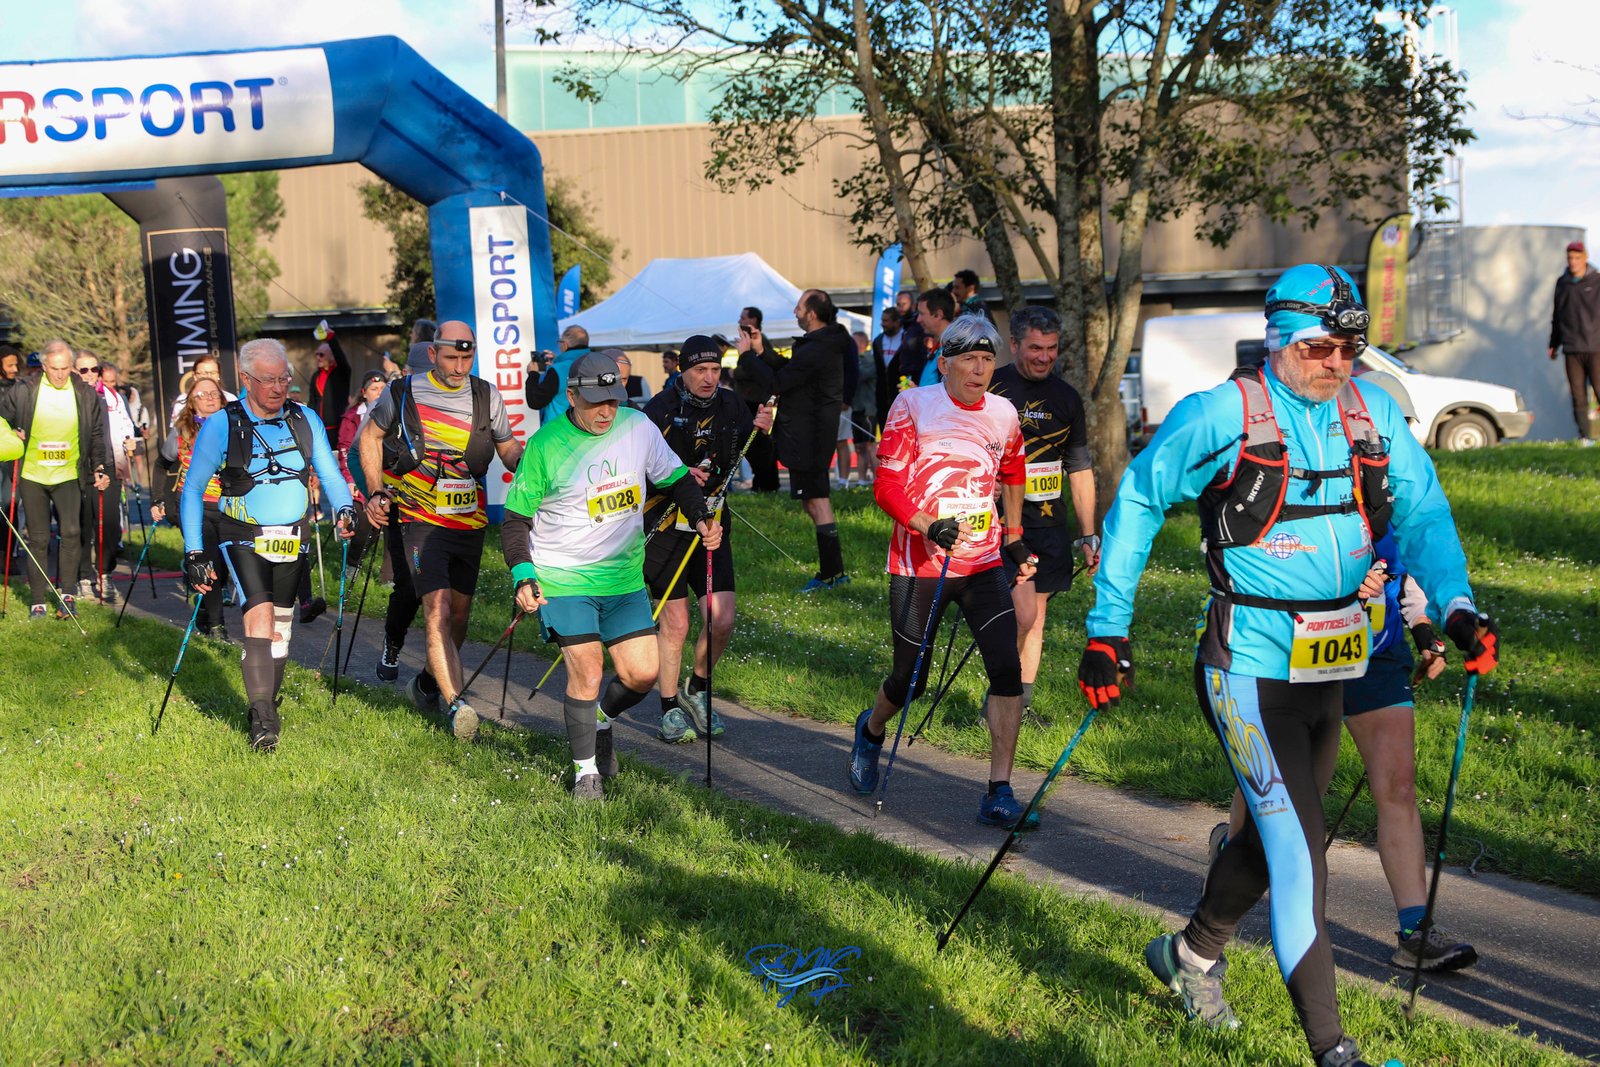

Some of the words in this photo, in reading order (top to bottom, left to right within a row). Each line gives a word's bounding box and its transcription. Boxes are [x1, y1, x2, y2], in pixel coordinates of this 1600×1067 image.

[203, 247, 218, 338] PERFORMANCE
[169, 247, 208, 374] TIMING
[1024, 408, 1053, 420] ACSM33
[43, 450, 66, 460] 1038
[1031, 476, 1059, 491] 1030
[445, 491, 477, 506] 1032
[597, 489, 635, 514] 1028
[264, 540, 294, 554] 1040
[1309, 634, 1362, 665] 1043
